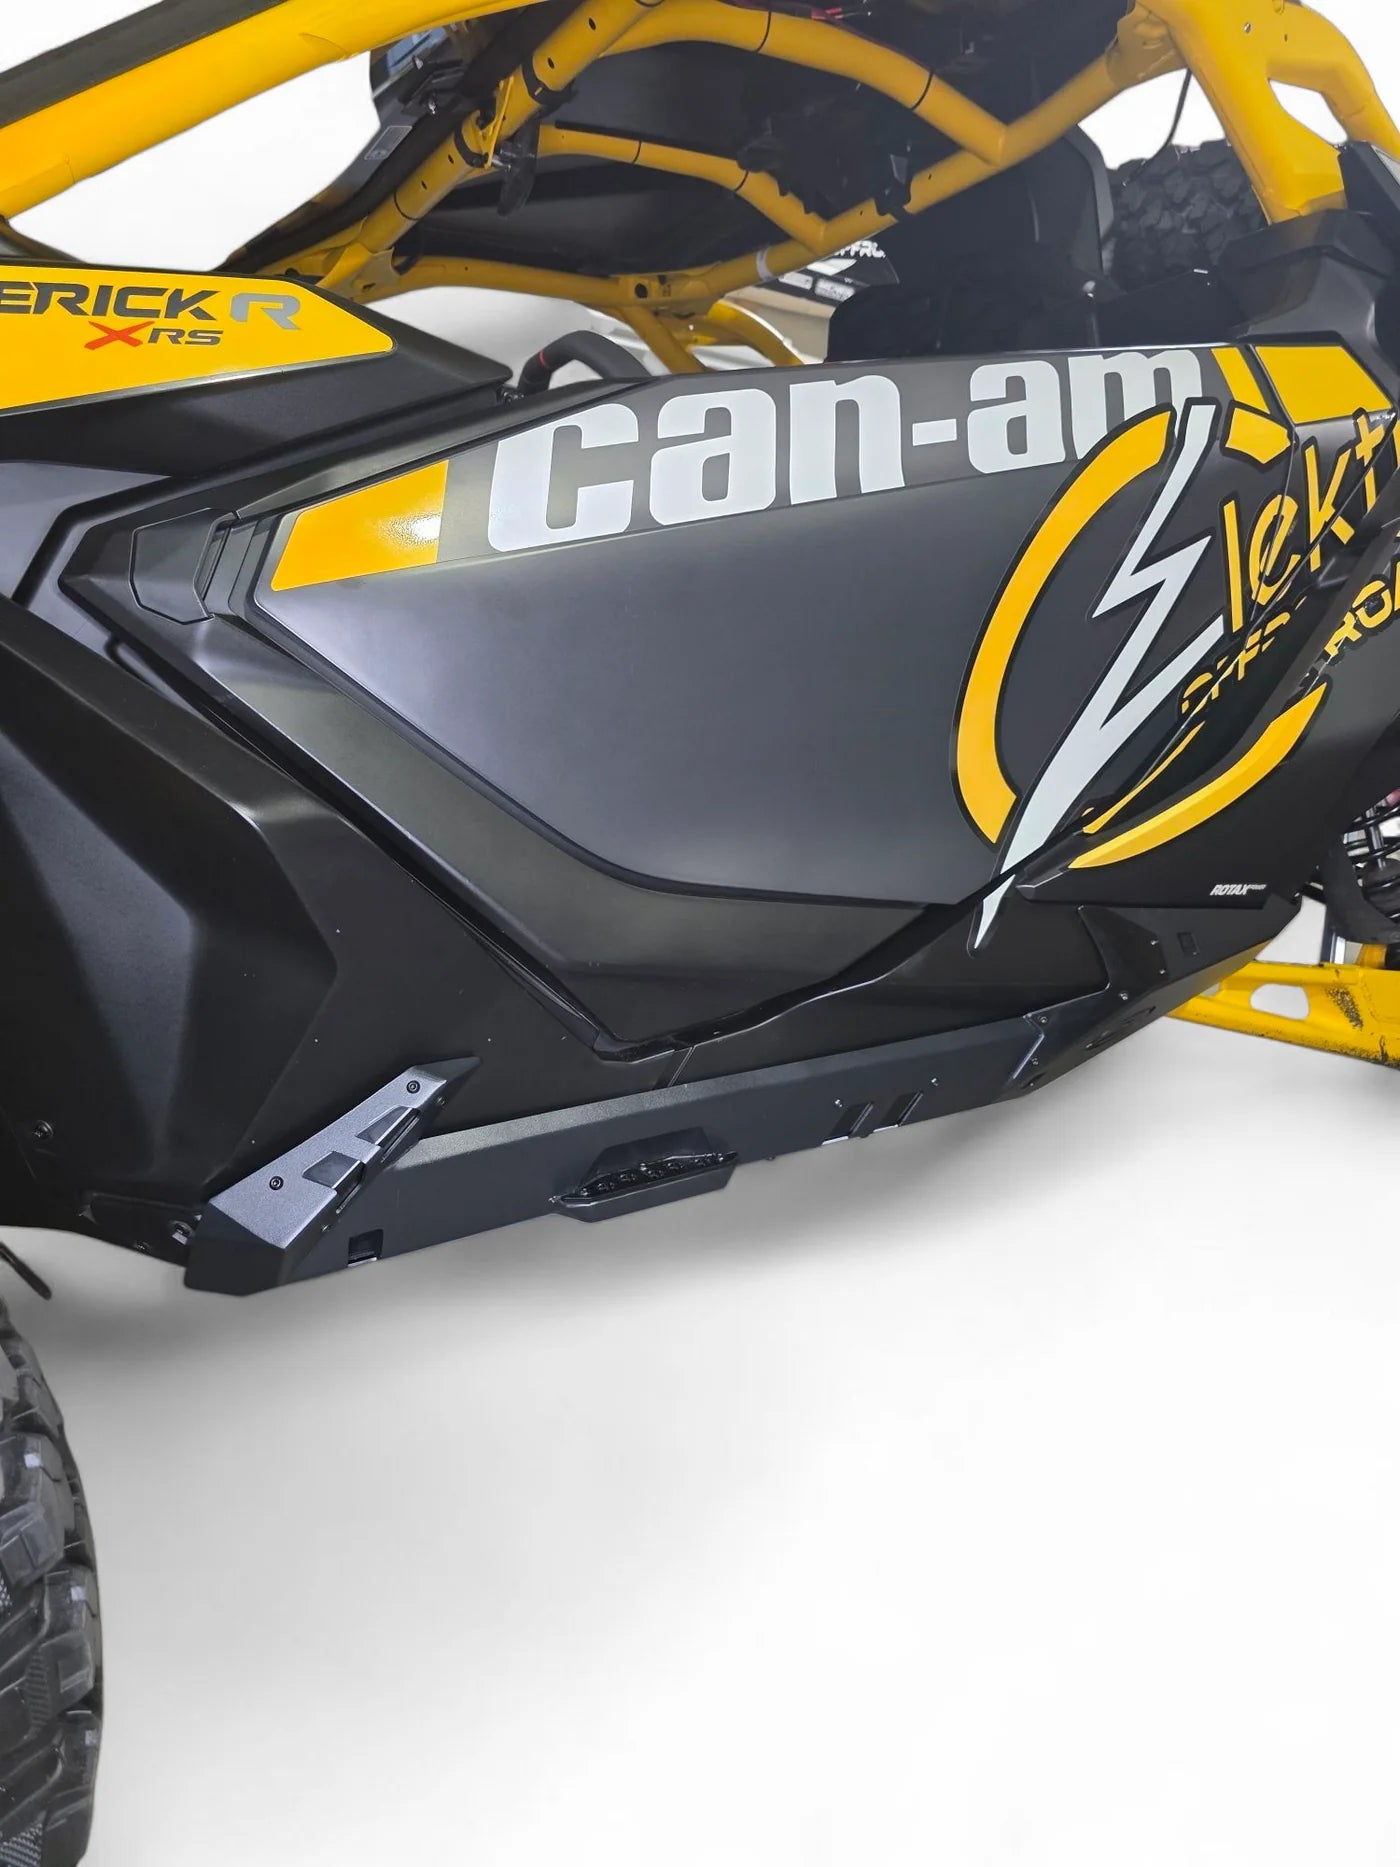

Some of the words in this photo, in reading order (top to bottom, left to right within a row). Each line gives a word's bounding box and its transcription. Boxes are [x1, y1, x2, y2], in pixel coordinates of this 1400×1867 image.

[229, 292, 301, 330] R
[84, 320, 223, 350] XRS
[1209, 884, 1250, 896] ROTAX
